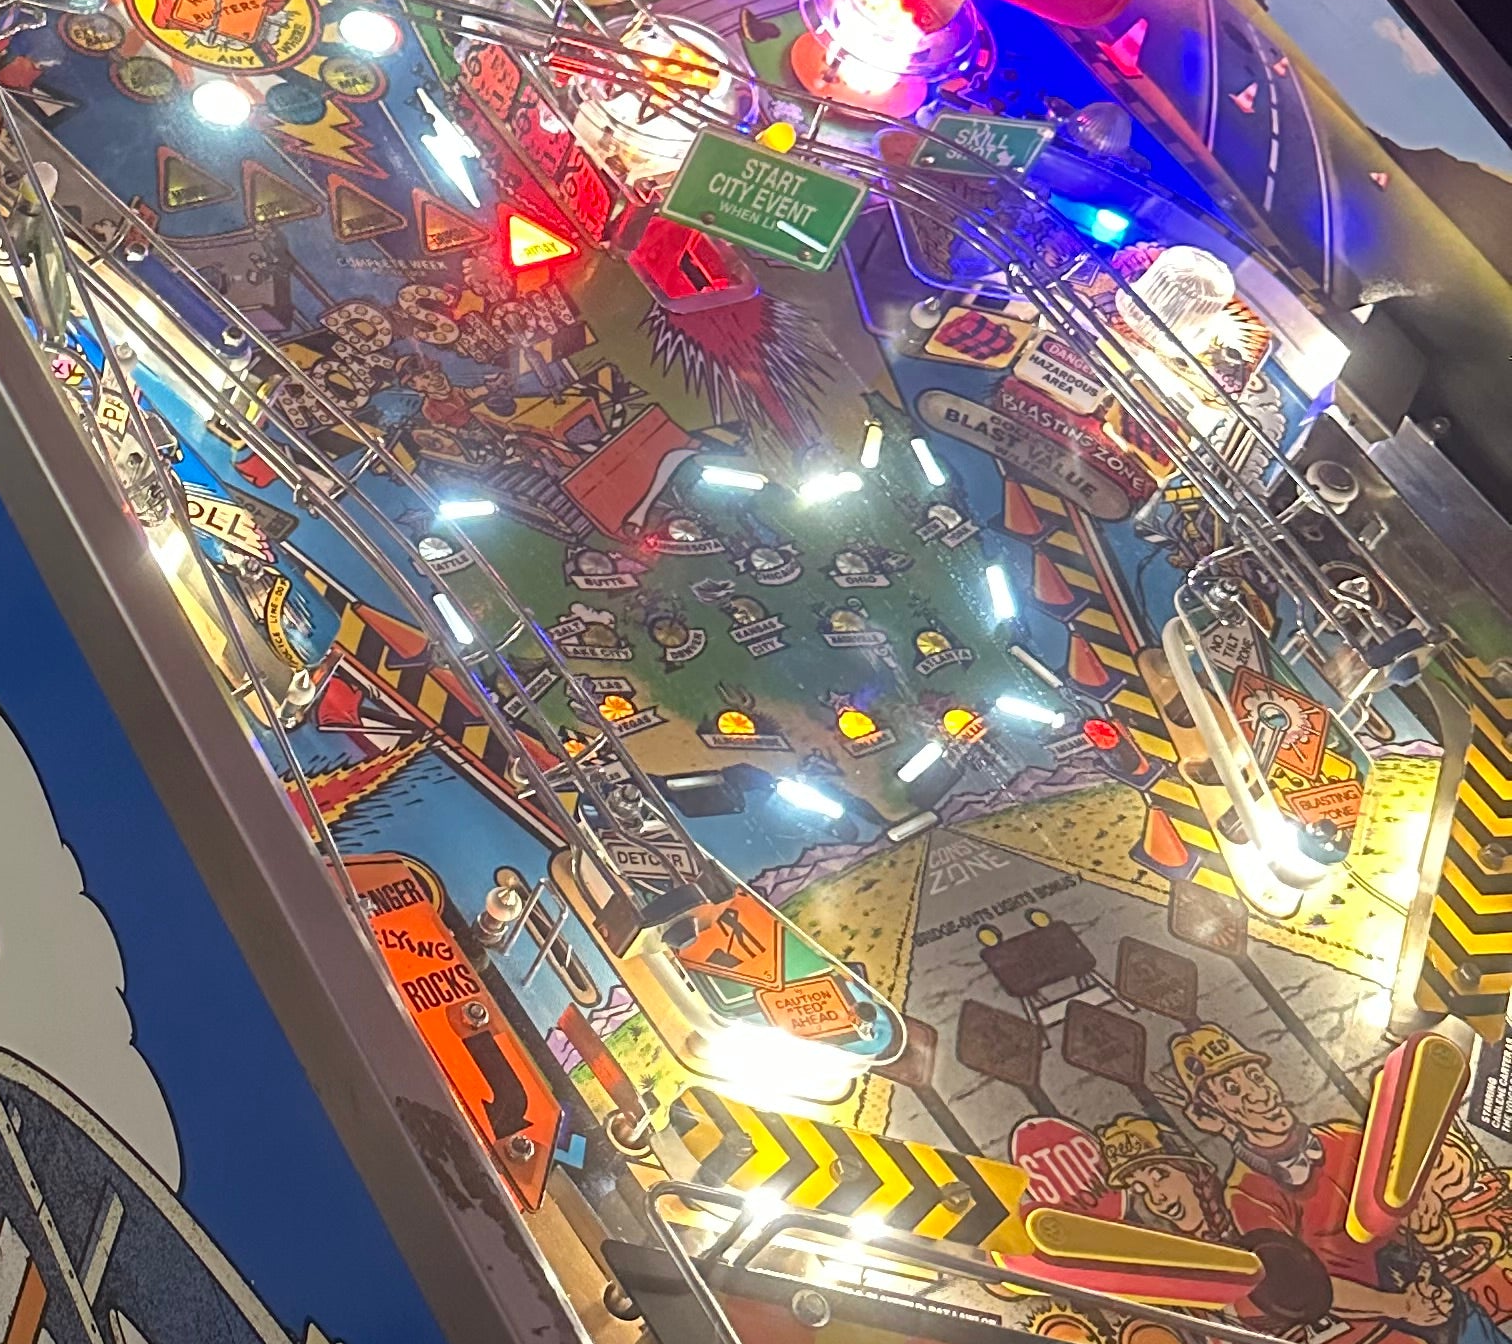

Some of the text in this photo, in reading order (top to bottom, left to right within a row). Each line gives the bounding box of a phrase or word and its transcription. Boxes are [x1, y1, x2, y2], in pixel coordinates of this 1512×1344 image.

[740, 157, 809, 198] START
[707, 170, 820, 228] CITY EVENT
[718, 199, 761, 230] WHEN
[1028, 354, 1099, 398] HAZARDOUS
[1041, 373, 1075, 396] AREA
[944, 407, 1022, 449] BLAST
[1027, 439, 1098, 498] VALUE
[1001, 392, 1096, 449] BLASTING
[1094, 445, 1146, 492] ZONE
[584, 576, 628, 587] BUTTE
[846, 575, 878, 585] OHIO
[553, 621, 582, 637] SALT
[738, 621, 778, 641] KANSAS
[564, 646, 632, 659] LAKE CITY
[751, 640, 778, 655] CITY
[1213, 633, 1224, 654] NO
[1223, 632, 1240, 658] TILT
[1235, 636, 1255, 667] ZONE
[599, 680, 622, 690] LAS
[616, 714, 652, 734] VEGAS
[1298, 788, 1359, 812] BLASTING
[928, 849, 1012, 896] ZONE
[401, 963, 482, 1014] ROCKS
[774, 989, 832, 1010] CAUTION
[790, 1009, 840, 1030] AHEAD
[1481, 1076, 1498, 1125] STARRING
[1018, 1135, 1106, 1205] STOP
